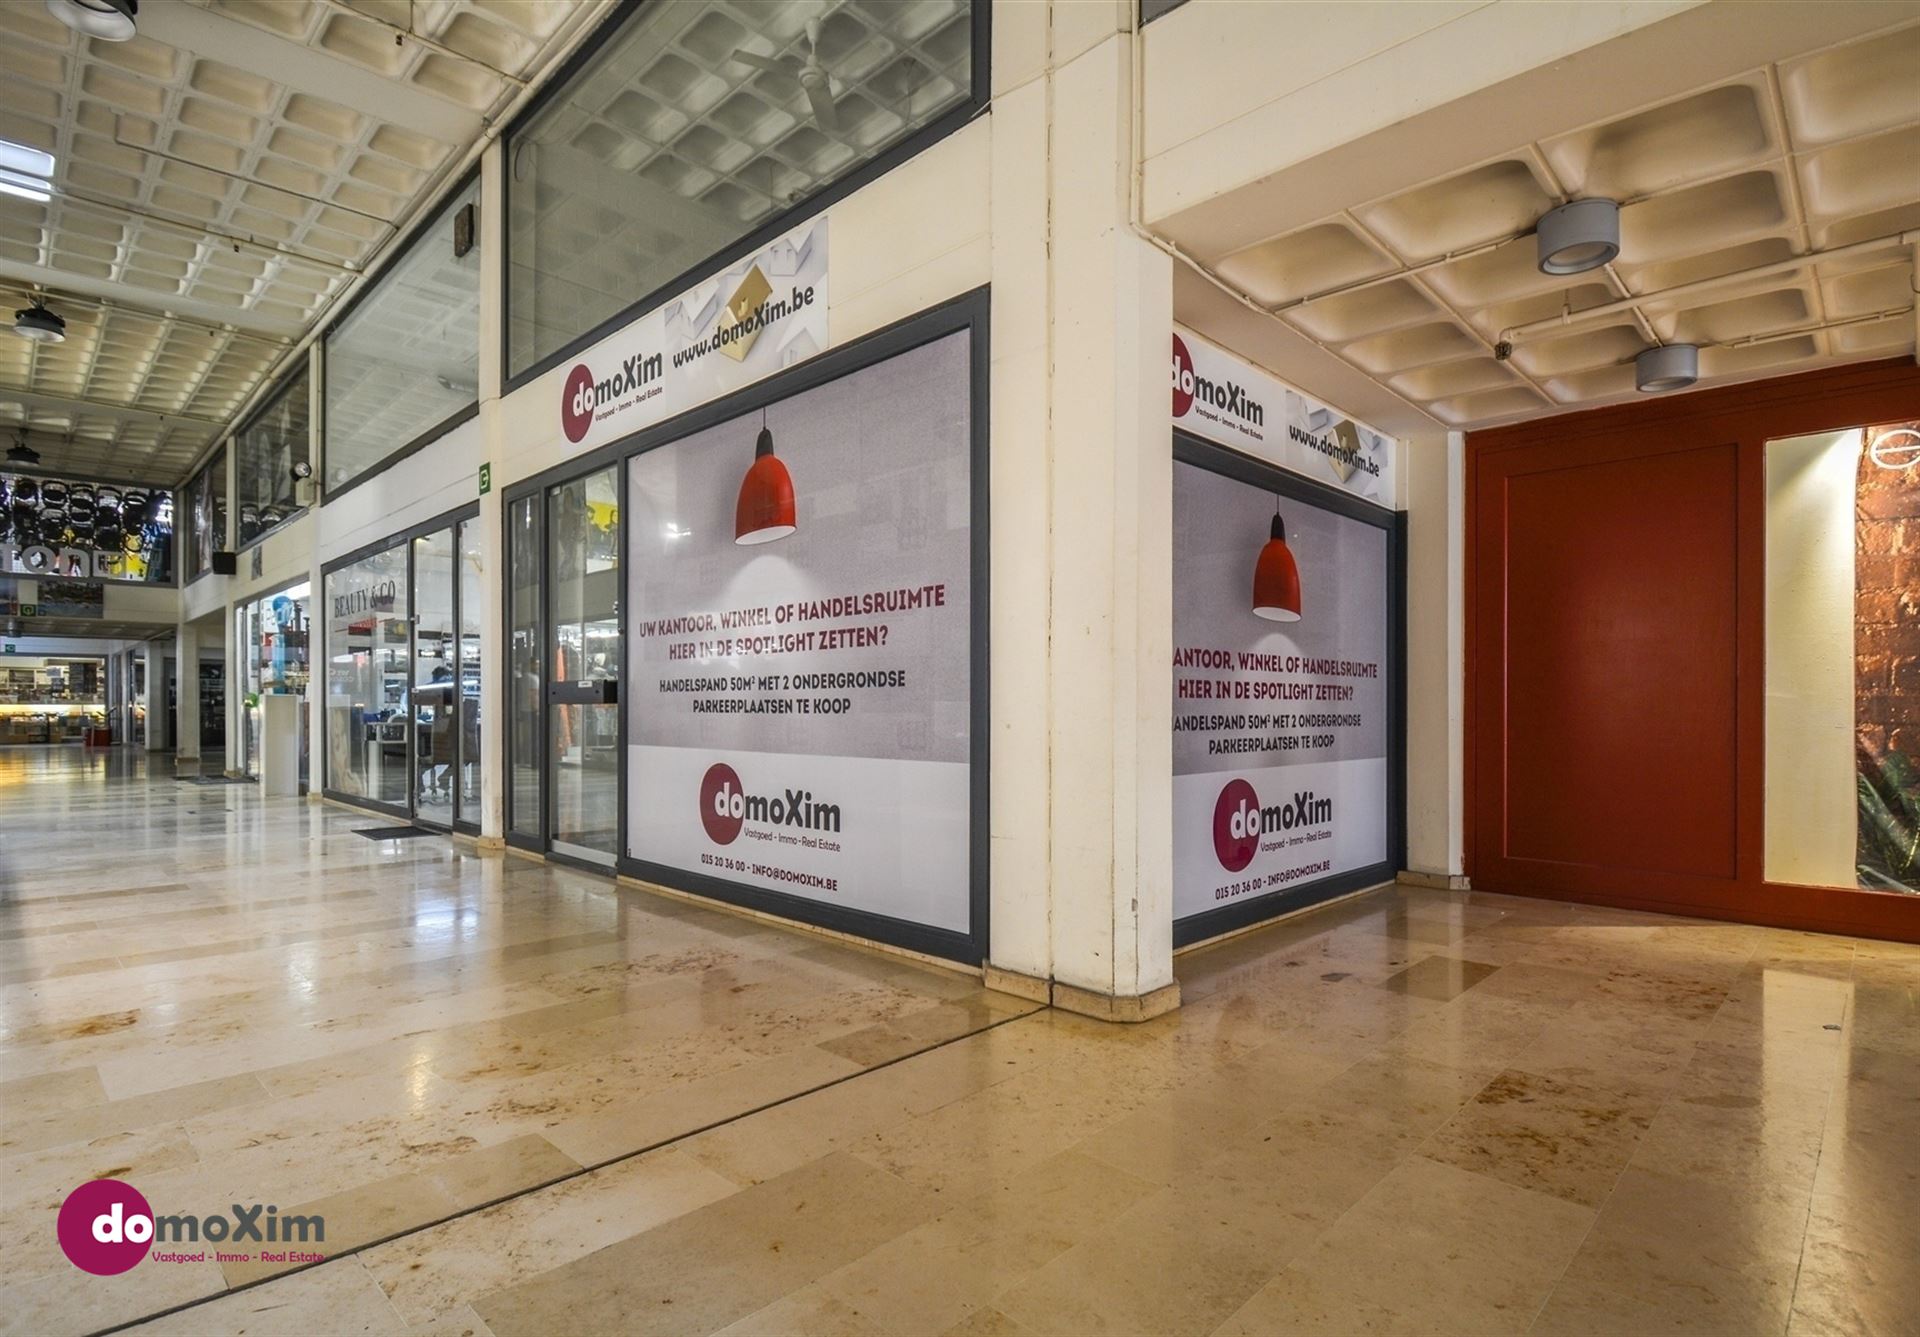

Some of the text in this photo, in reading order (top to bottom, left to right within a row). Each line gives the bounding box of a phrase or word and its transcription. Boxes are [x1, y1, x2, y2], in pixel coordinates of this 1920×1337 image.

[673, 286, 814, 368] www.domoXim.be
[572, 352, 663, 417] domoXim
[1289, 424, 1379, 478] www.domoXim.be
[334, 588, 369, 618] BEAUTY
[380, 580, 396, 606] CO
[640, 584, 945, 637] UW KANTOOR, WINKEL OF HANDELSRUIMTE
[669, 625, 888, 660] HIER IN DE SPOTLIGHT ZETTEN?
[1173, 648, 1377, 678] ANTOOR, WINKEL OF HANDELSRUIMTE
[659, 676, 728, 693] HANDELSPAND
[758, 675, 780, 690] MET
[782, 675, 790, 690] 2
[792, 670, 906, 689] ONDERGRONDSE
[1179, 679, 1353, 701] HIER IN DE SPOTLIGHT ZETTEN?
[693, 698, 851, 715] PARKEERPLAATSEN TE KOOP
[1173, 715, 1245, 732] ANDELSPAND
[1272, 714, 1290, 728] MET
[1291, 714, 1297, 728] 2
[1298, 713, 1361, 727] ONDERGRONDSE
[1209, 734, 1335, 754] PARKEERPLAATSEN TE KOOP
[714, 782, 840, 832] domoXim
[1230, 791, 1332, 840] domoXim
[744, 827, 773, 842] Vastgoed
[778, 833, 797, 845] Immo
[802, 836, 817, 849] Real
[819, 839, 841, 852] Estate
[1260, 839, 1285, 852] Vastgoed
[1289, 836, 1303, 846] Immo
[1306, 833, 1317, 843] Real
[1318, 830, 1332, 841] Estate
[701, 854, 713, 866] 015
[714, 856, 724, 867] 20
[725, 859, 734, 870] 36
[735, 861, 745, 872] 00
[752, 864, 838, 891] INFO@DOMOXIM.BE
[1215, 887, 1229, 900] 015
[1231, 883, 1240, 896] 20
[1242, 880, 1250, 893] 36
[1252, 878, 1262, 890] 00
[1268, 860, 1330, 886] INFO@DOMOXIM.BE
